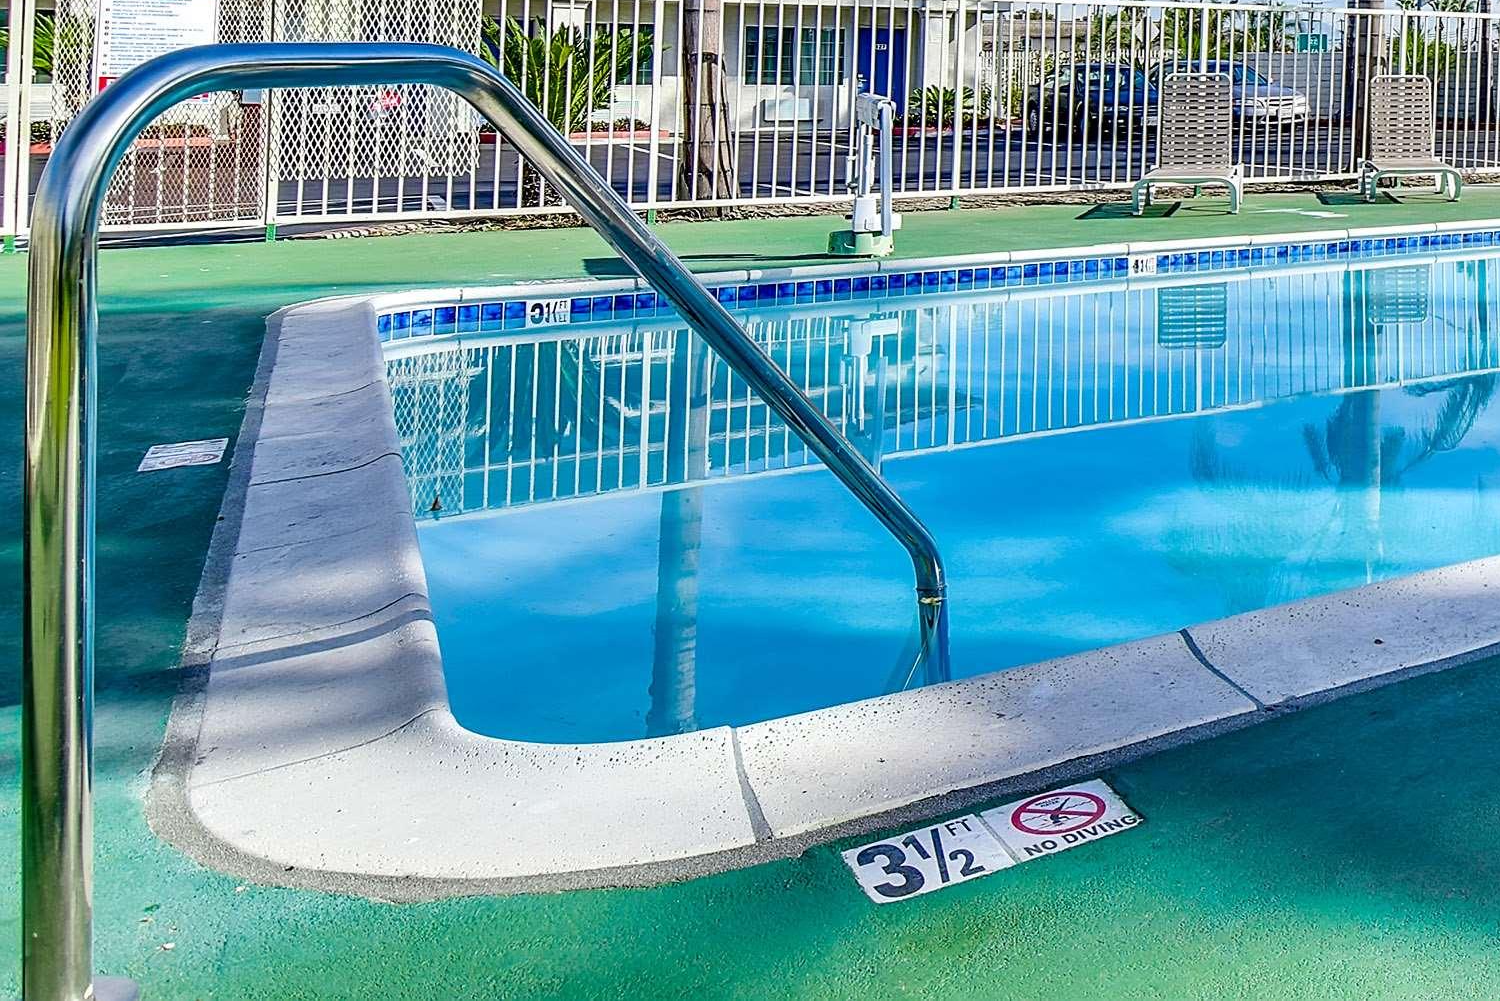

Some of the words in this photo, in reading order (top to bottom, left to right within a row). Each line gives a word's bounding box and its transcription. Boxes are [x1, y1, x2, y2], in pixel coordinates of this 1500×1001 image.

[947, 818, 973, 837] FT
[1023, 839, 1058, 857] NO
[1061, 813, 1141, 843] DIVING
